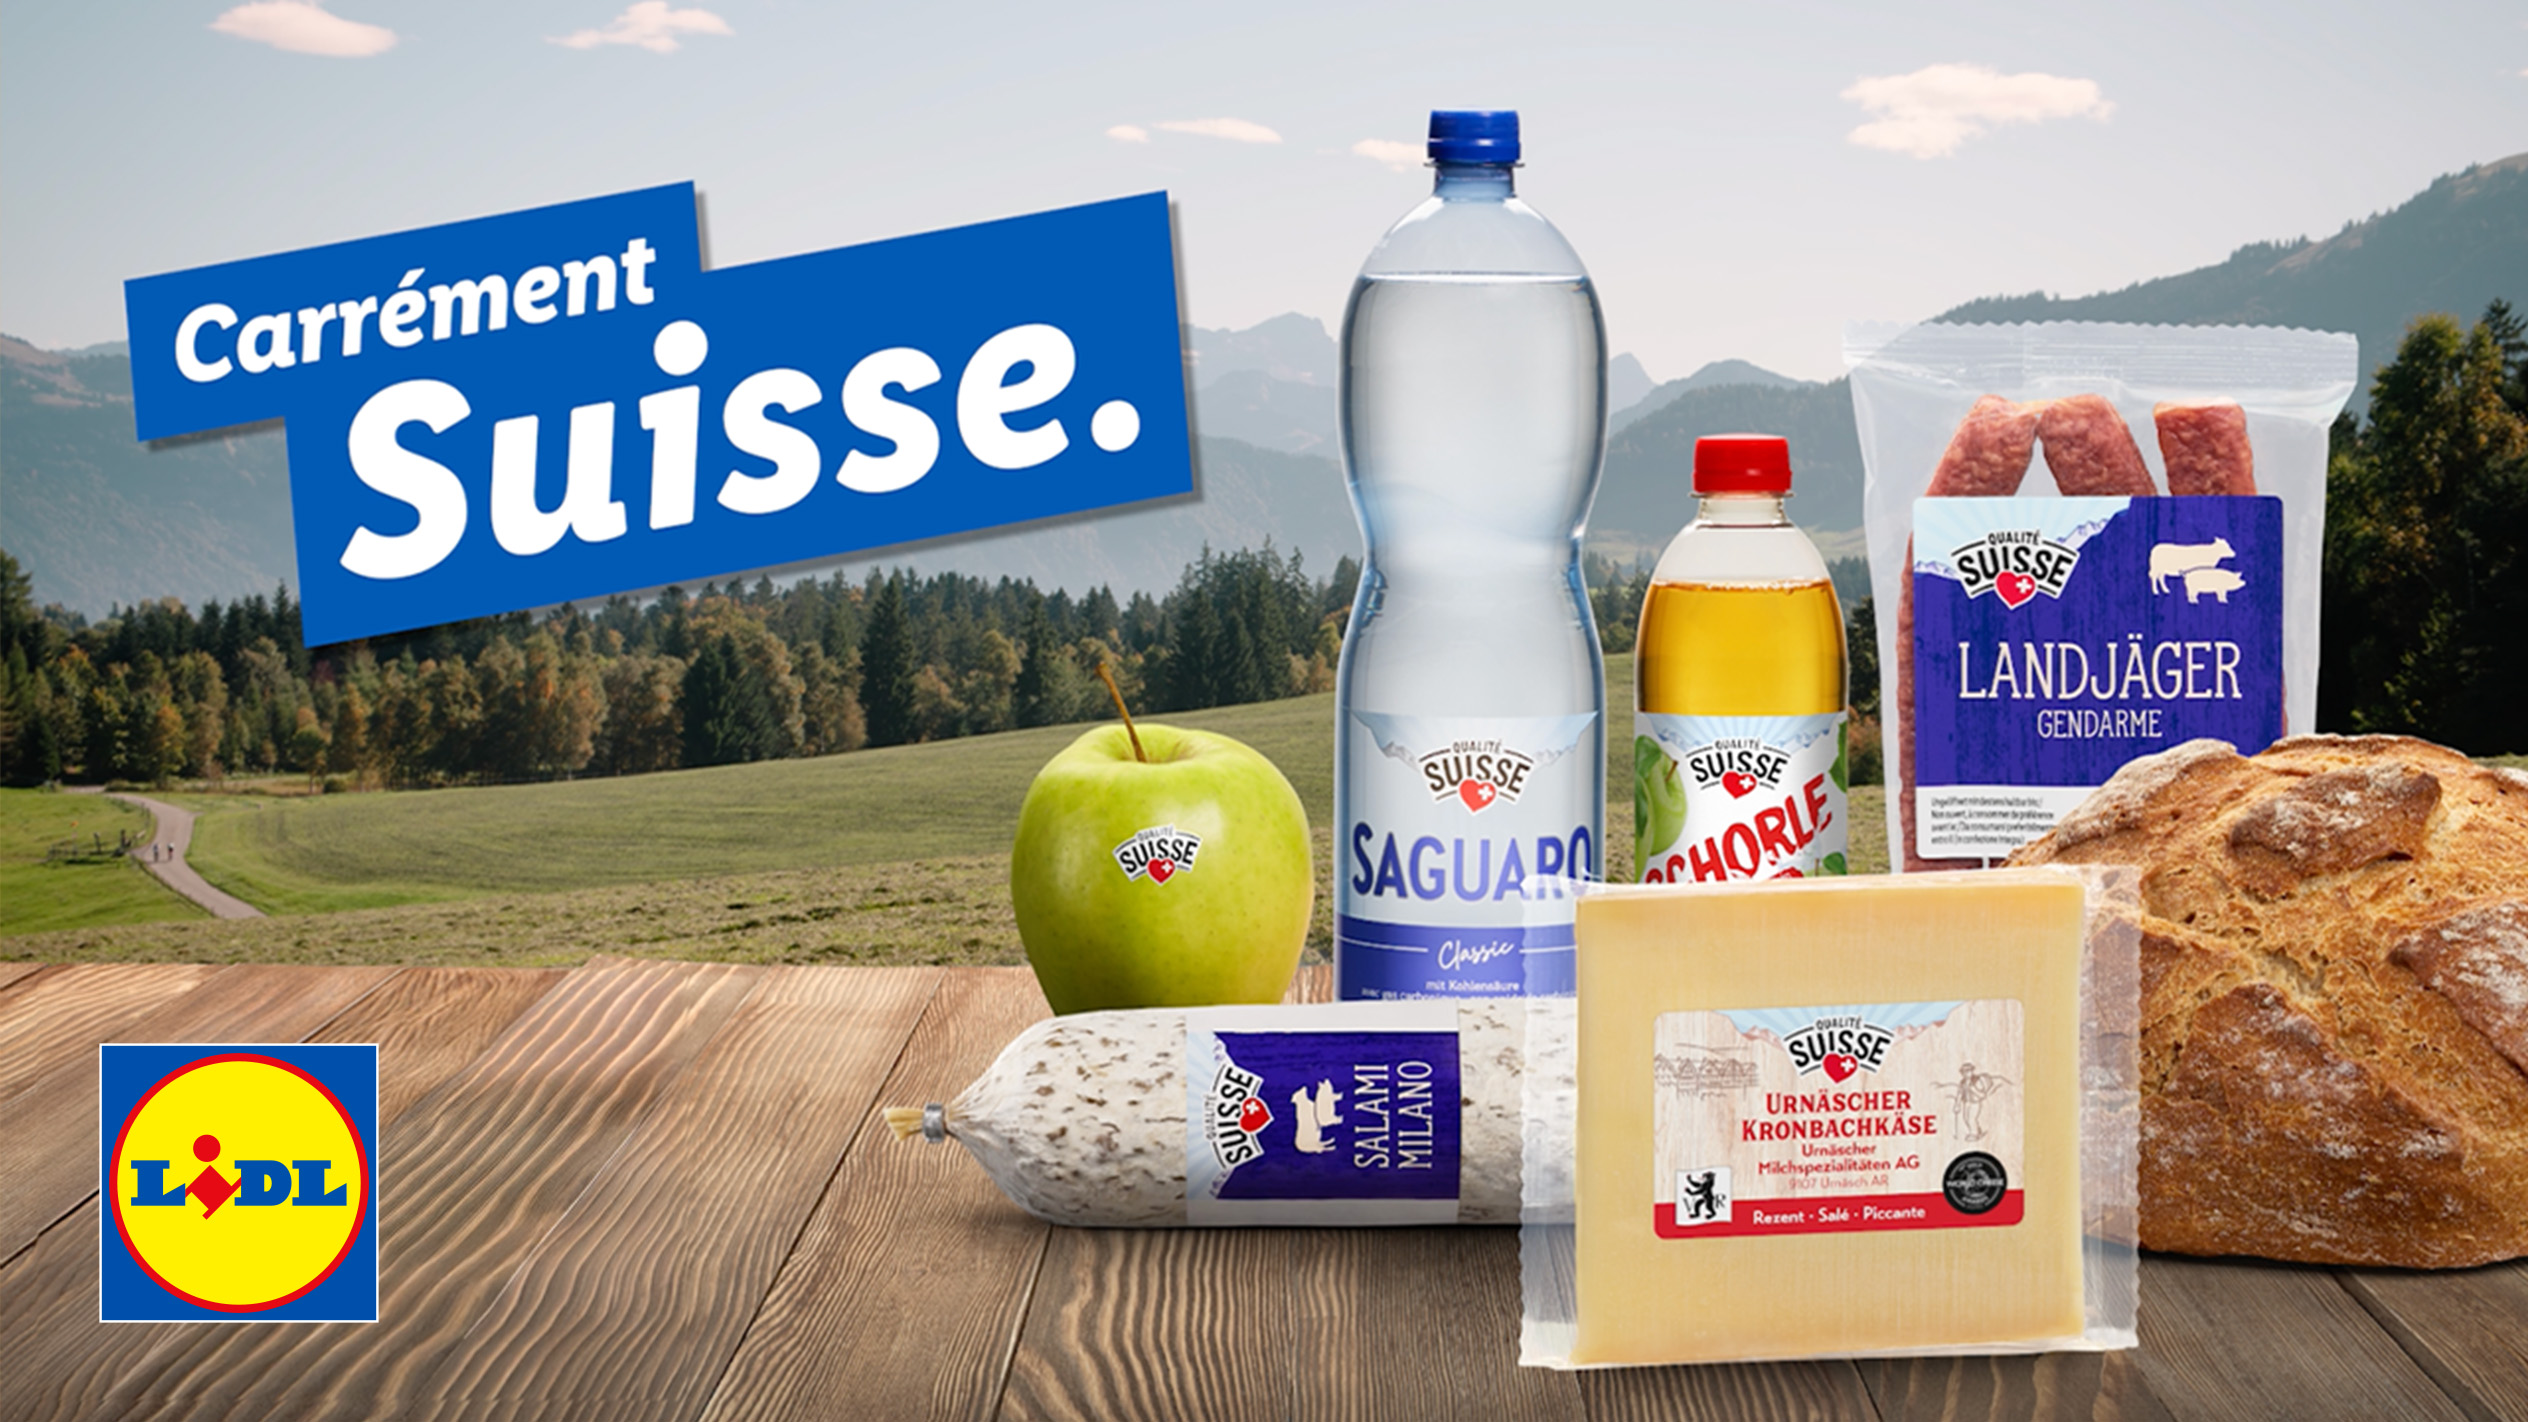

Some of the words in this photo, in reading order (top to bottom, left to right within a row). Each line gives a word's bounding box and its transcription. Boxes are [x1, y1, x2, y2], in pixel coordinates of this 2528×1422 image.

[1989, 529, 2041, 545] QUALITÉ
[1957, 545, 2074, 588] SUISSE
[1958, 633, 2243, 700] LANDJÄGER
[2037, 709, 2163, 738] GENDARME
[1453, 739, 1502, 754] QUALITÉ
[1423, 753, 1531, 793] SUISSE
[1690, 750, 1789, 783] SUISSE
[1119, 838, 1198, 873] SUISSE
[1352, 822, 1591, 901] SAGUARO
[1438, 940, 1514, 970] Classic
[1425, 980, 1445, 991] mit
[1448, 980, 1519, 992] Kohlensäure
[1815, 1015, 1862, 1030] QUALITÉ
[1788, 1030, 1891, 1067] SUISSE
[1217, 1067, 1254, 1165] SUISSE
[1354, 1064, 1389, 1168] SALAMI
[1397, 1061, 1432, 1169] MILANO
[1766, 1088, 1911, 1115] URNÄSCHER
[1742, 1112, 1937, 1141] KRONBACHKÄSE
[1801, 1142, 1876, 1157] Urnäscher
[1758, 1159, 1891, 1177] Milchspezialitäten
[1895, 1155, 1920, 1170] AG
[1871, 1174, 1889, 1187] AR
[1753, 1210, 1805, 1225] Rezent
[1818, 1207, 1849, 1222] Salé
[1863, 1204, 1926, 1221] Piccante
